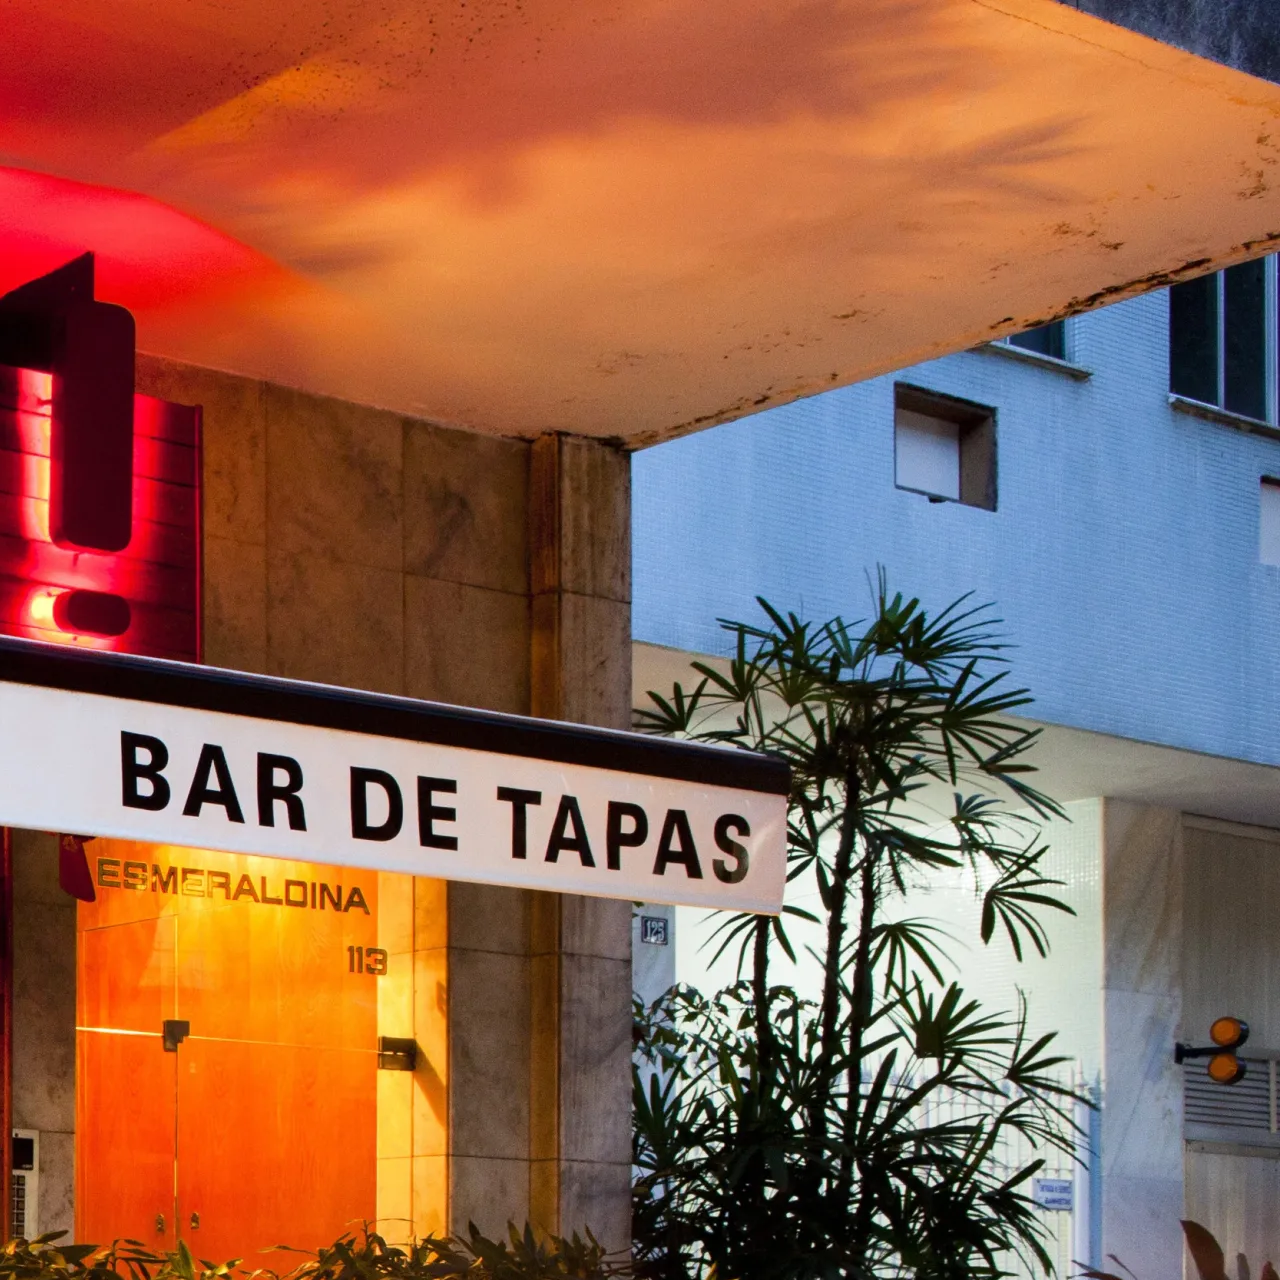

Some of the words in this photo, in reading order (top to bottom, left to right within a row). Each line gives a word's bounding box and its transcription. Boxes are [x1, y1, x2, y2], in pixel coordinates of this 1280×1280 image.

[120, 730, 308, 831] BAR
[350, 765, 459, 852] DE
[496, 786, 752, 884] TAPAS
[96, 857, 371, 916] ESMERALDINA
[646, 920, 665, 942] 125
[347, 945, 388, 976] 113
